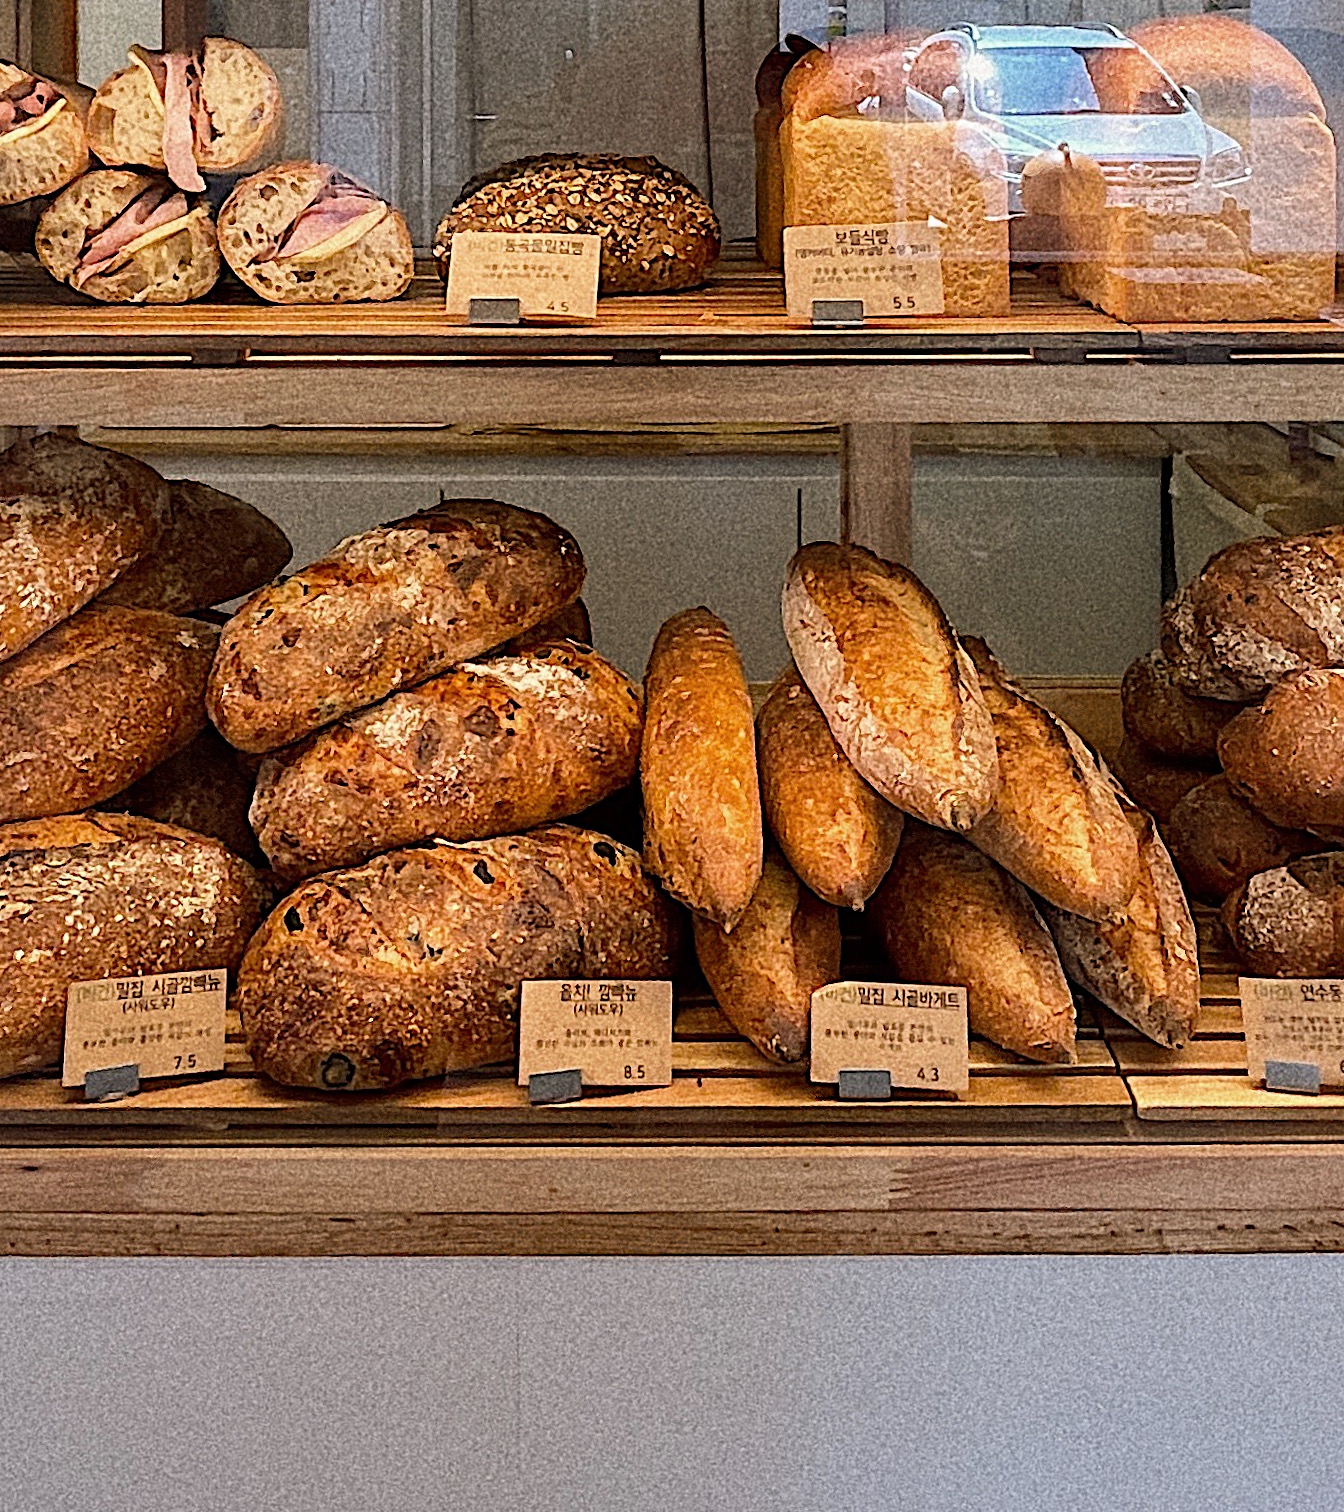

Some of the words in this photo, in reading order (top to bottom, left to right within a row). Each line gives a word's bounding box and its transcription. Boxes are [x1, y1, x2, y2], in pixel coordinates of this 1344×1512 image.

[116, 980, 144, 1000] 밀집
[857, 987, 885, 1006] 밀집
[892, 989, 960, 1009] 시골바게트
[174, 1054, 196, 1070] 7.5
[624, 1065, 645, 1080] 8.5
[916, 1067, 939, 1082] 4.3
